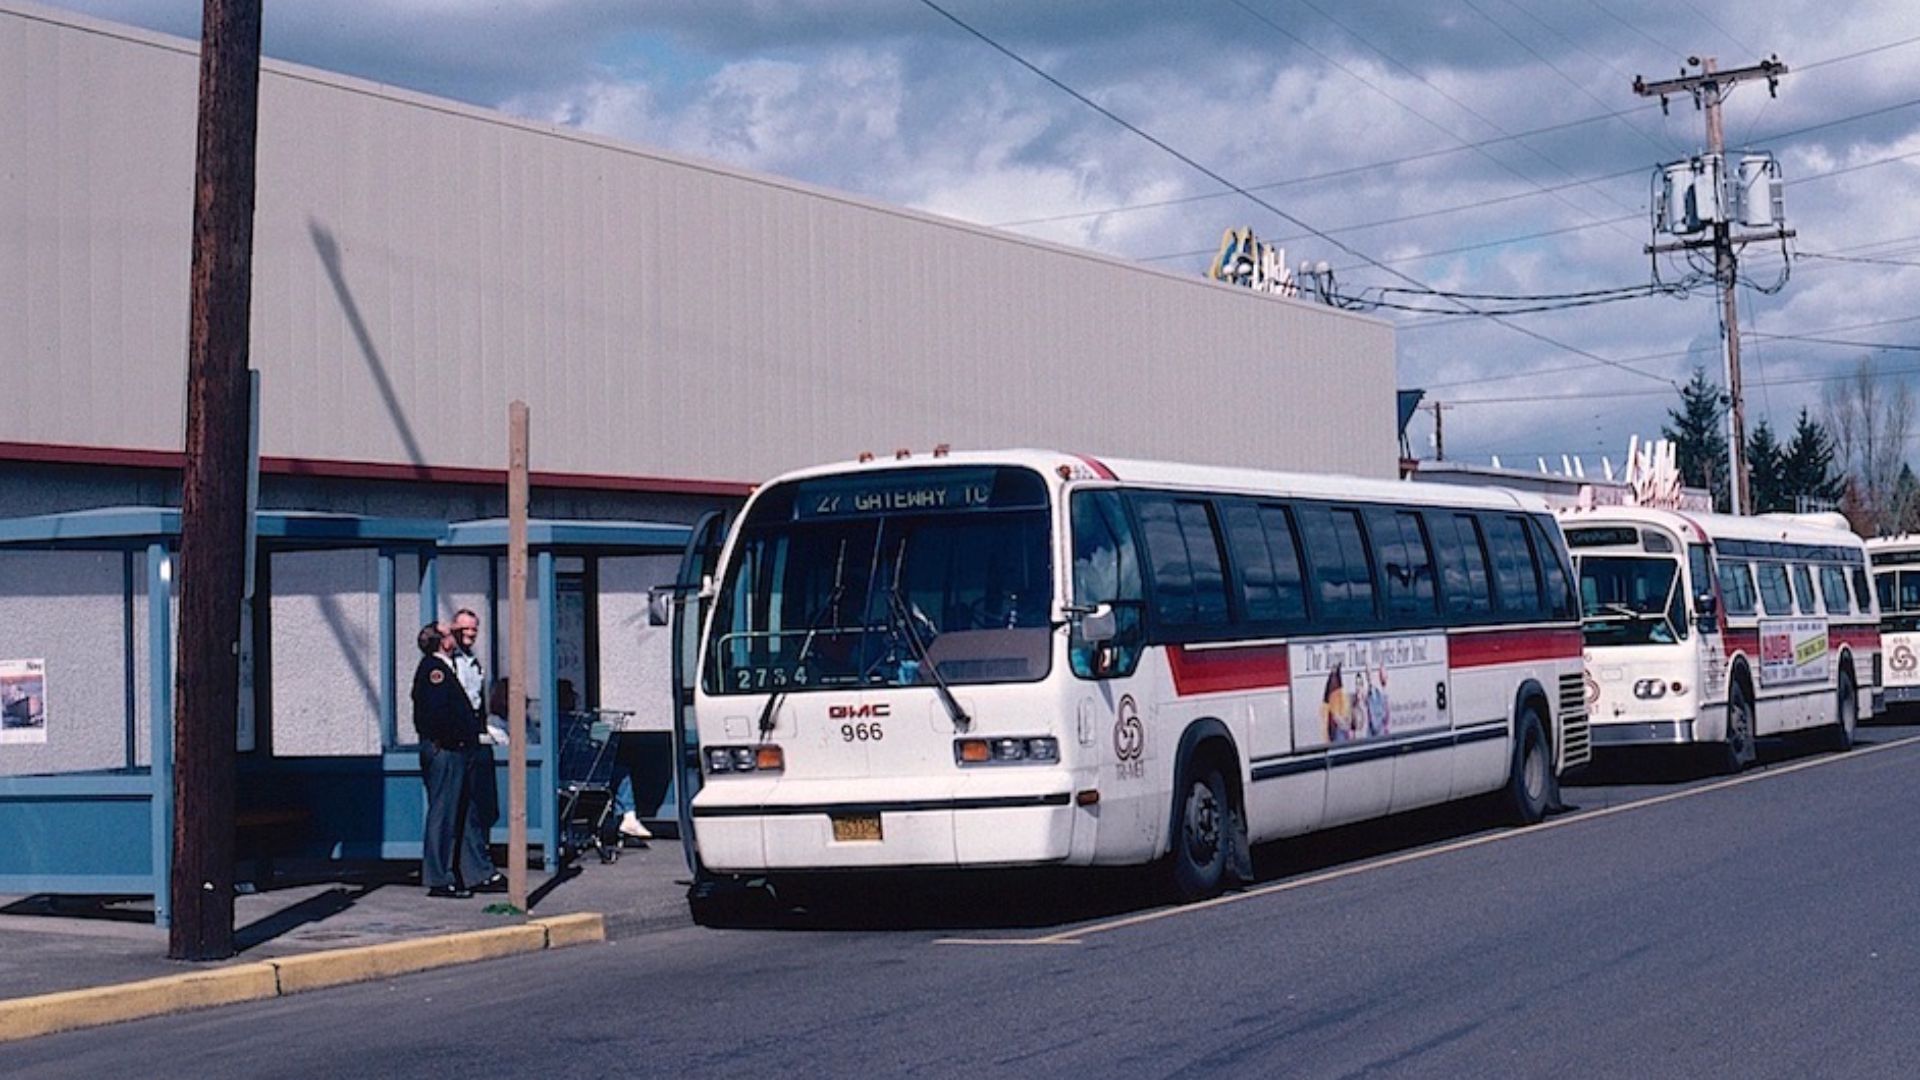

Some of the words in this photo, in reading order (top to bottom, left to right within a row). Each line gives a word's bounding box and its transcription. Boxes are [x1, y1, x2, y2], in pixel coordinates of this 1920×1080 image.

[854, 489, 948, 511] GATEWAY
[829, 704, 892, 718] GMC
[841, 722, 883, 742] 966
